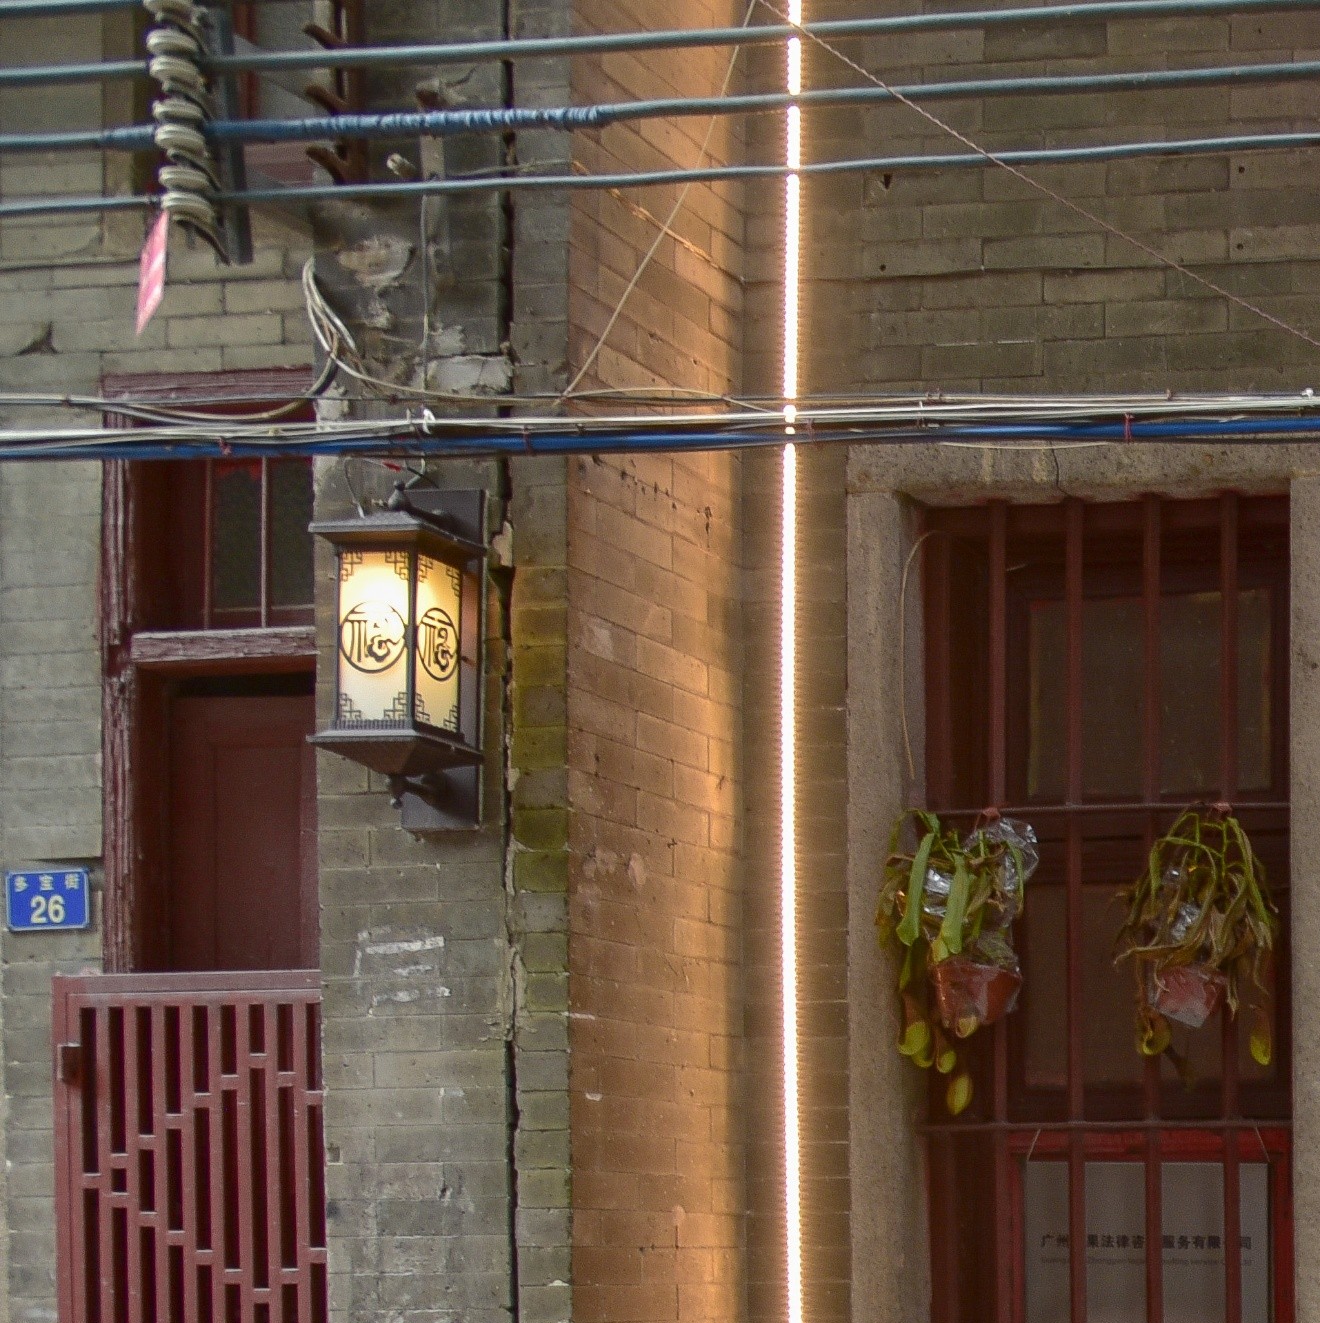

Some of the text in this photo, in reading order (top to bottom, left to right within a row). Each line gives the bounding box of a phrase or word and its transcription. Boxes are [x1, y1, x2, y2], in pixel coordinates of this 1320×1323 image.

[13, 873, 81, 893] 多宝街
[30, 894, 66, 924] 26
